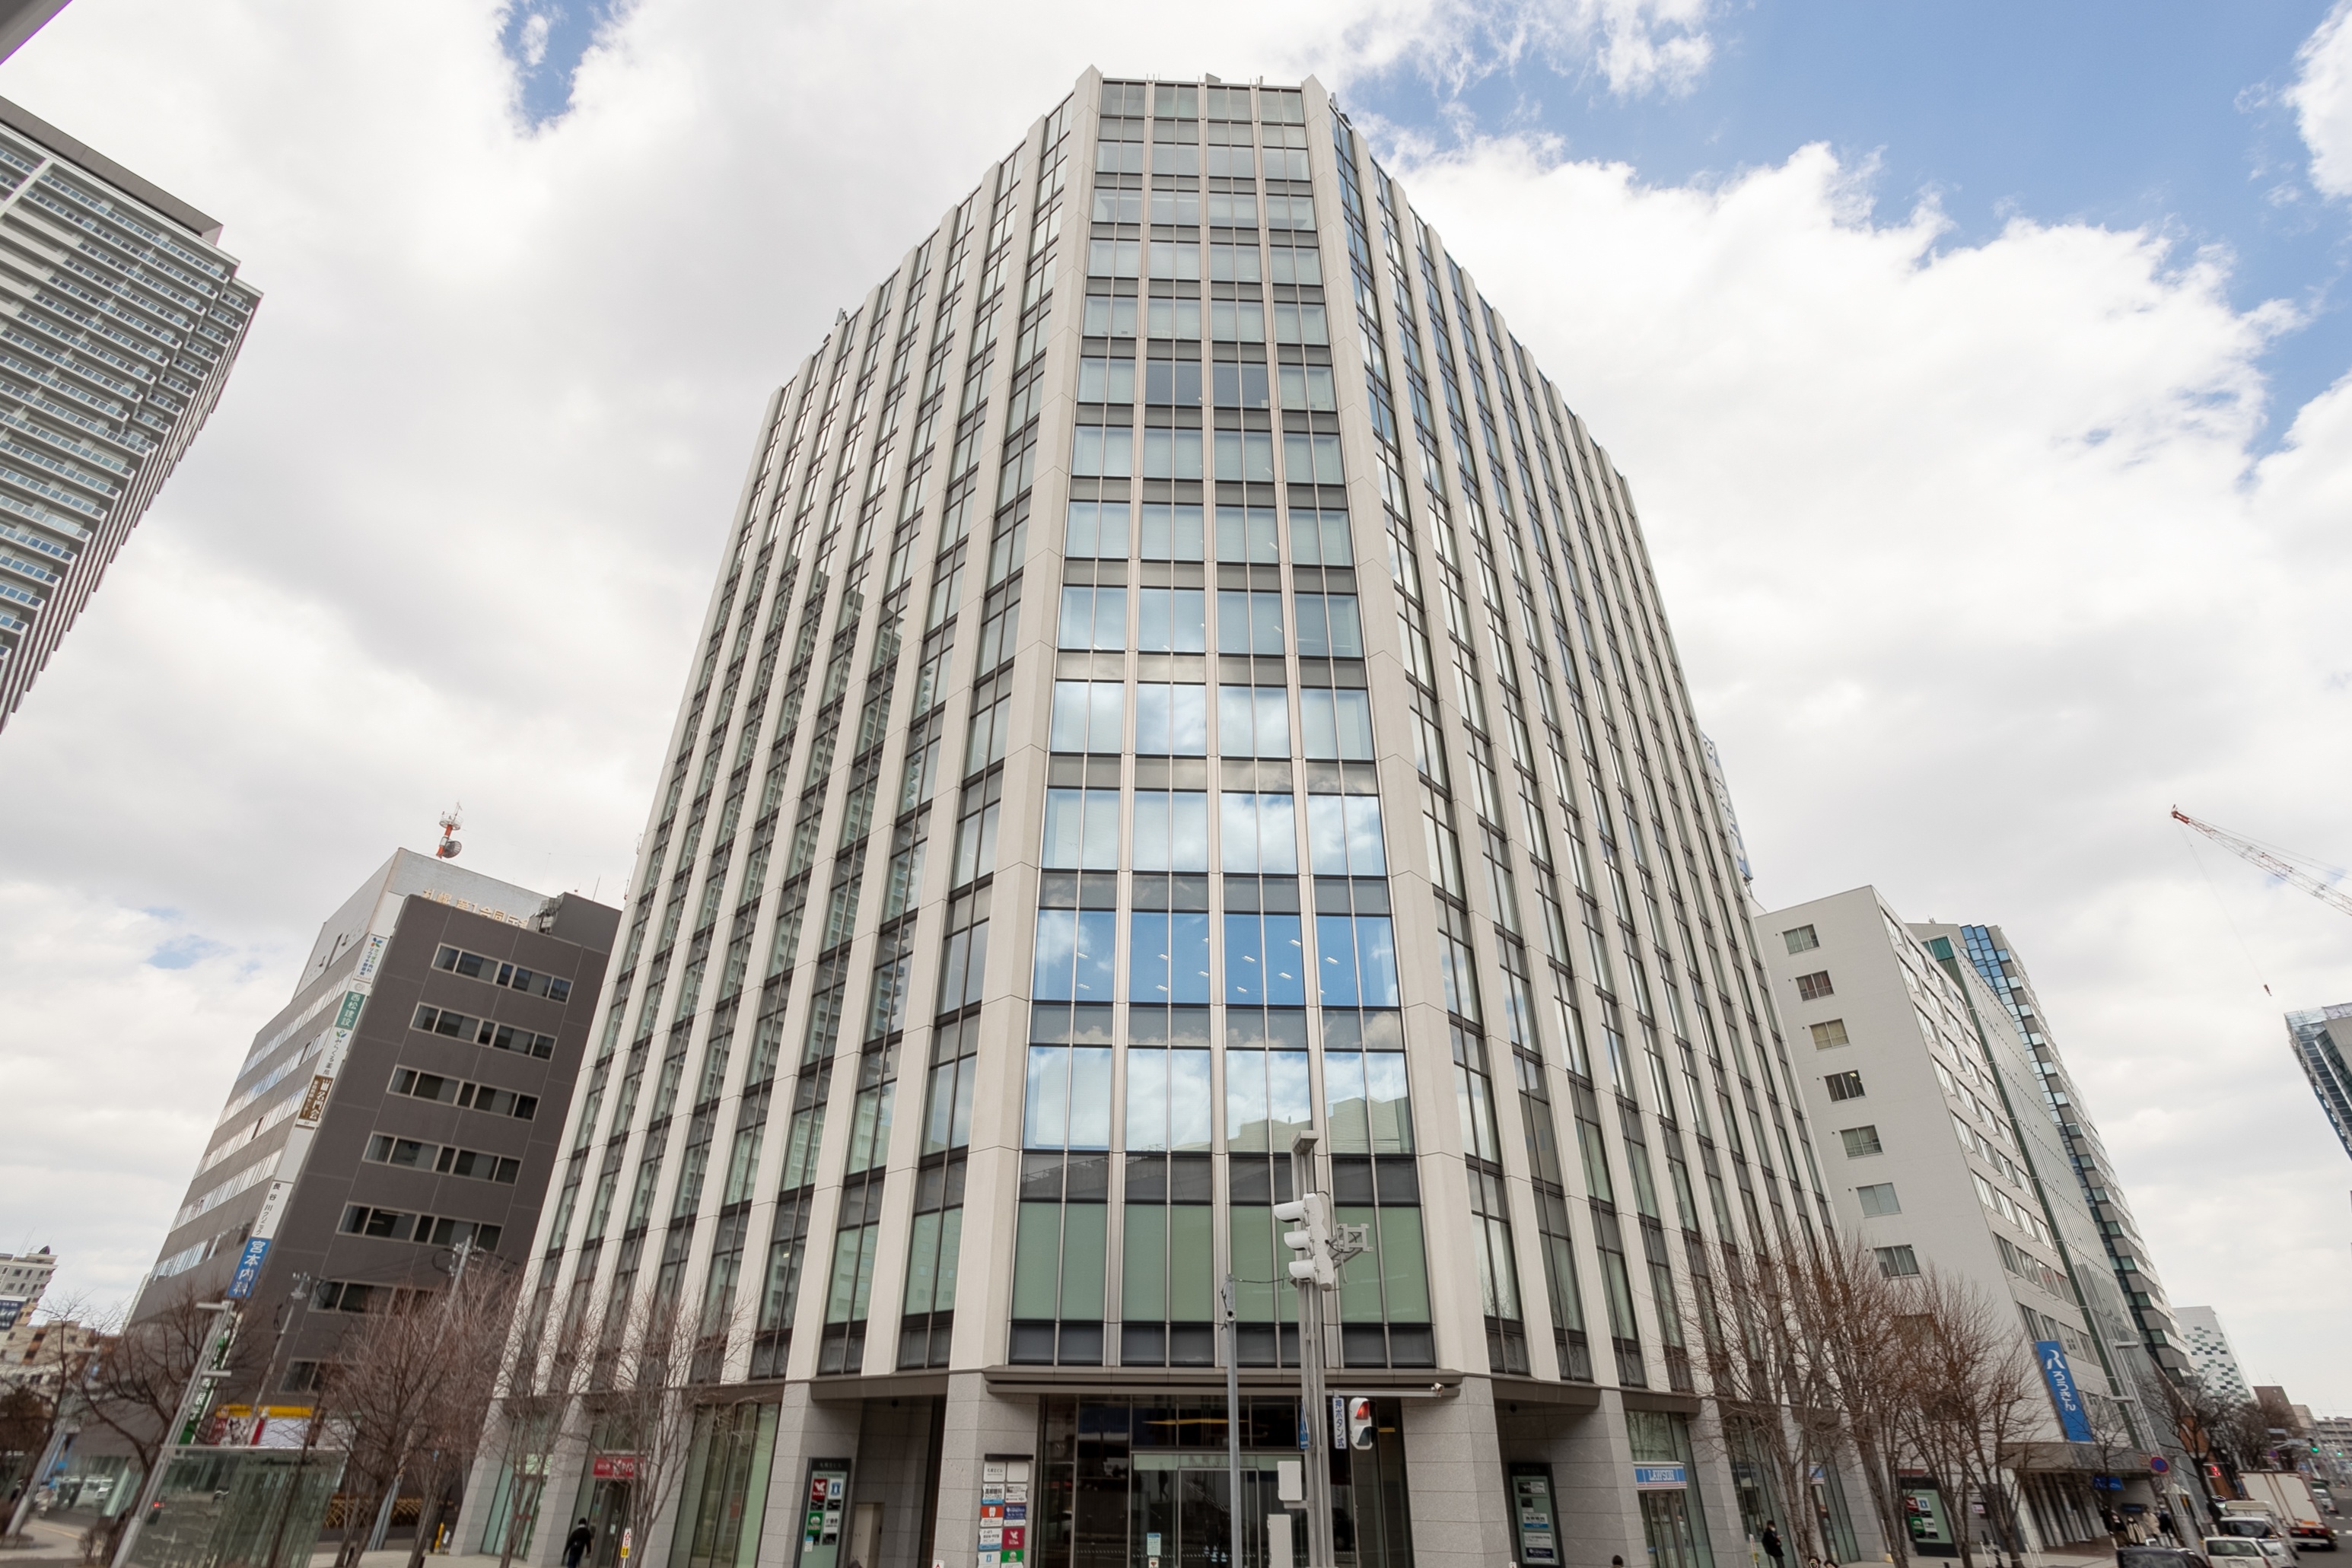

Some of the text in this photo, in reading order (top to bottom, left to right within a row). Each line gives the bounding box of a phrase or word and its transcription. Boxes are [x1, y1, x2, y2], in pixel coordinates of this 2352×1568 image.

[422, 888, 453, 905] 札幌
[341, 993, 361, 1026] 西松建設
[323, 1038, 342, 1075] みらくる薬局
[256, 1182, 281, 1236] 長谷川クリニック
[233, 1240, 266, 1295] 宮本内科
[1647, 1469, 1675, 1481] LAWSON
